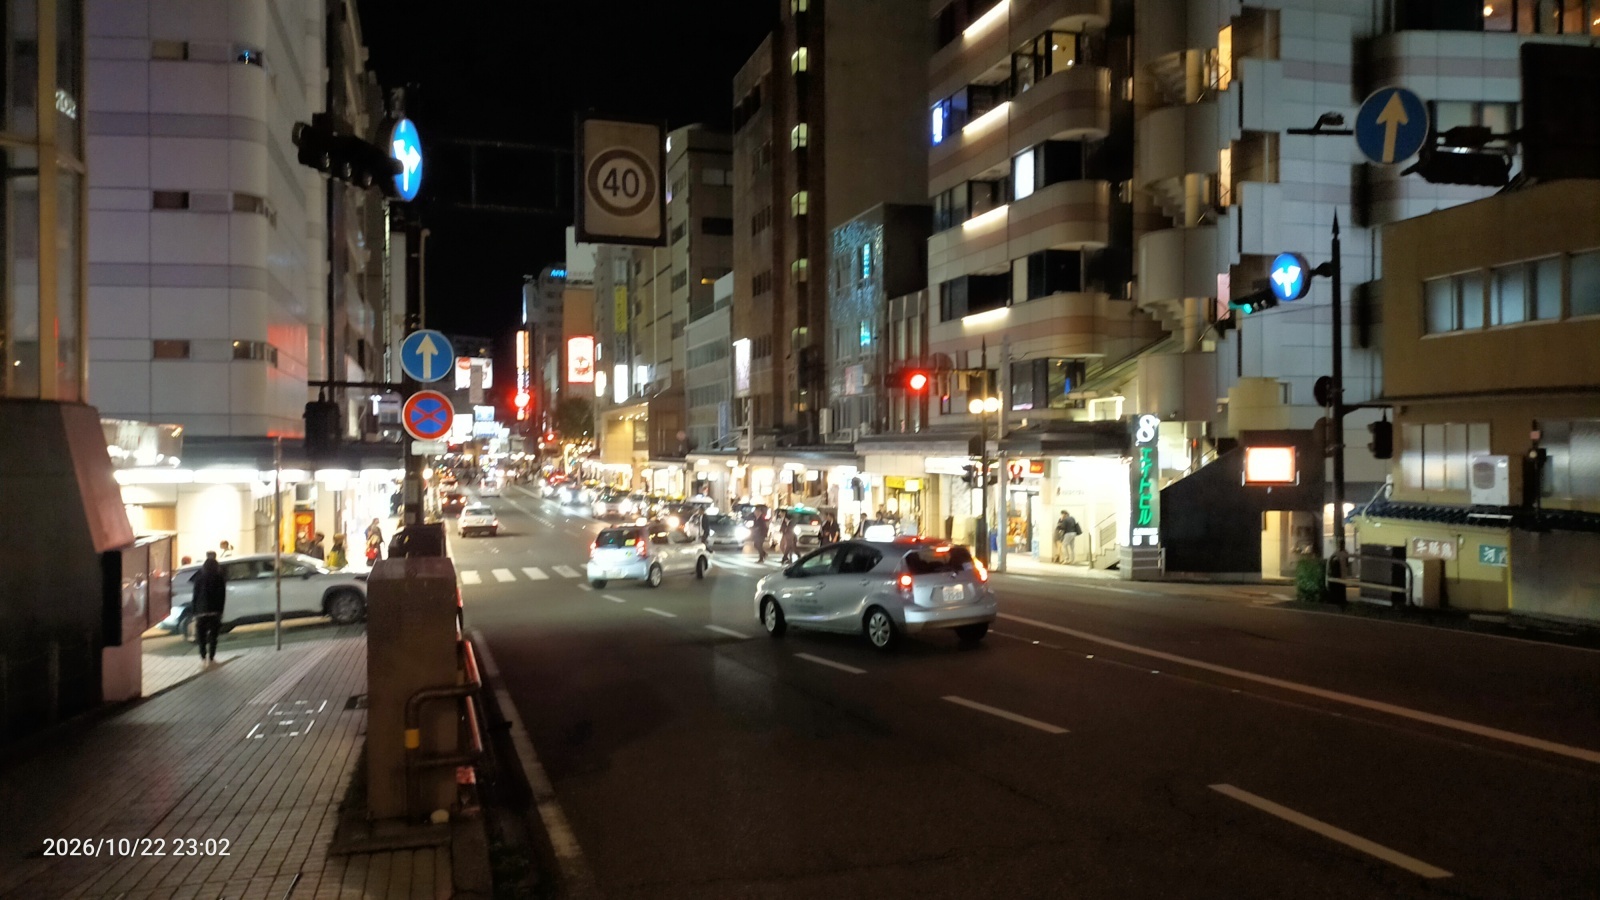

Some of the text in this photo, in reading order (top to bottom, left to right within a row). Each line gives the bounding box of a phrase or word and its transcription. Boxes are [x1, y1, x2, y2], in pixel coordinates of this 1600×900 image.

[602, 167, 640, 198] 40
[1138, 448, 1153, 526] エイトビル
